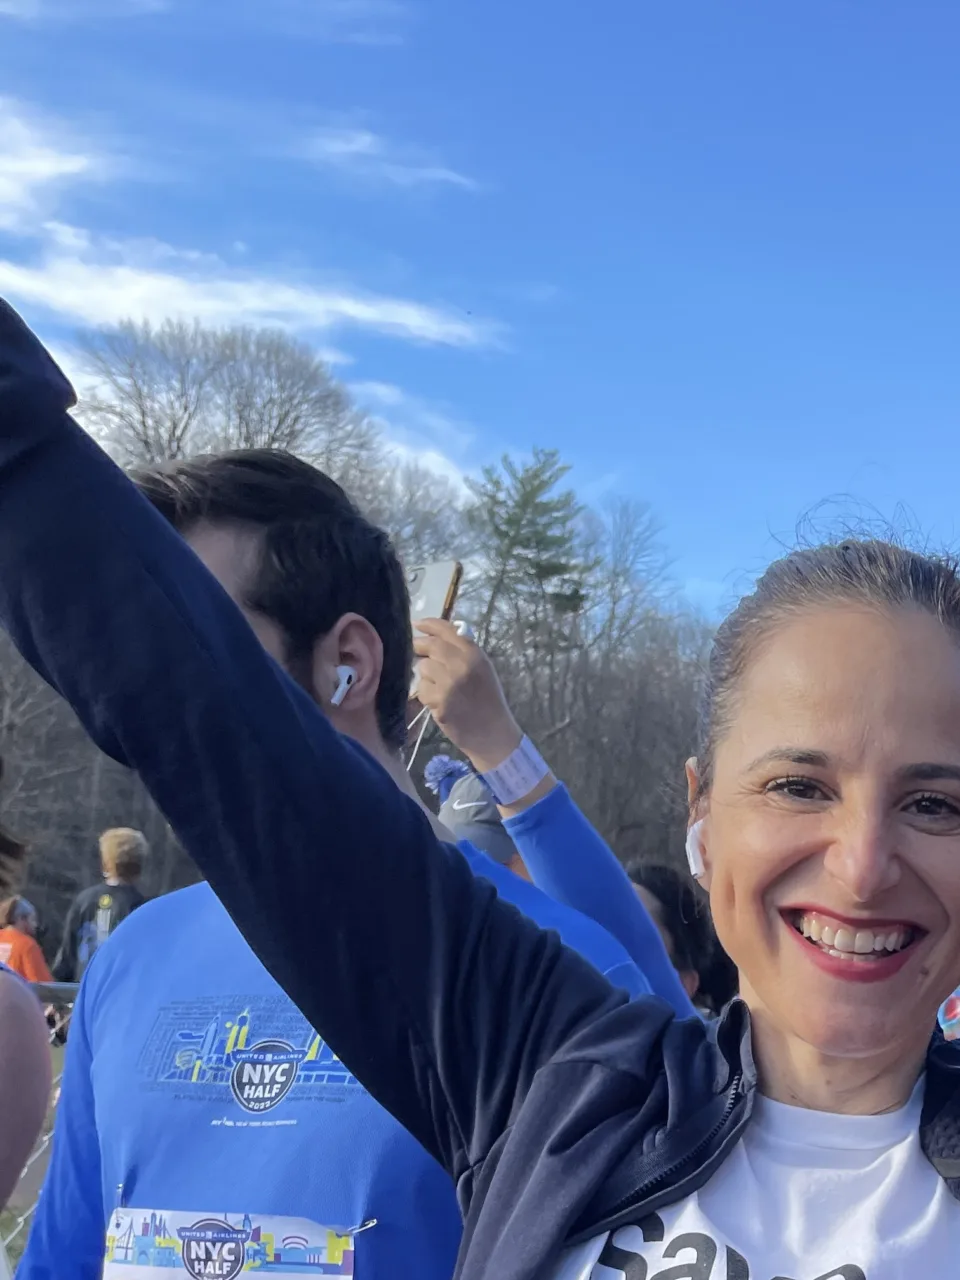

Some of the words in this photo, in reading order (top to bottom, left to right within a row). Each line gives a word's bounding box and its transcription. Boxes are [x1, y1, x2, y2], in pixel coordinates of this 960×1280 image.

[242, 1063, 290, 1083] NYC
[243, 1084, 281, 1098] HALF
[248, 1101, 271, 1110] 2022
[212, 1231, 246, 1239] AIRLINES
[190, 1241, 236, 1260] NYC
[194, 1260, 232, 1275] HALF
